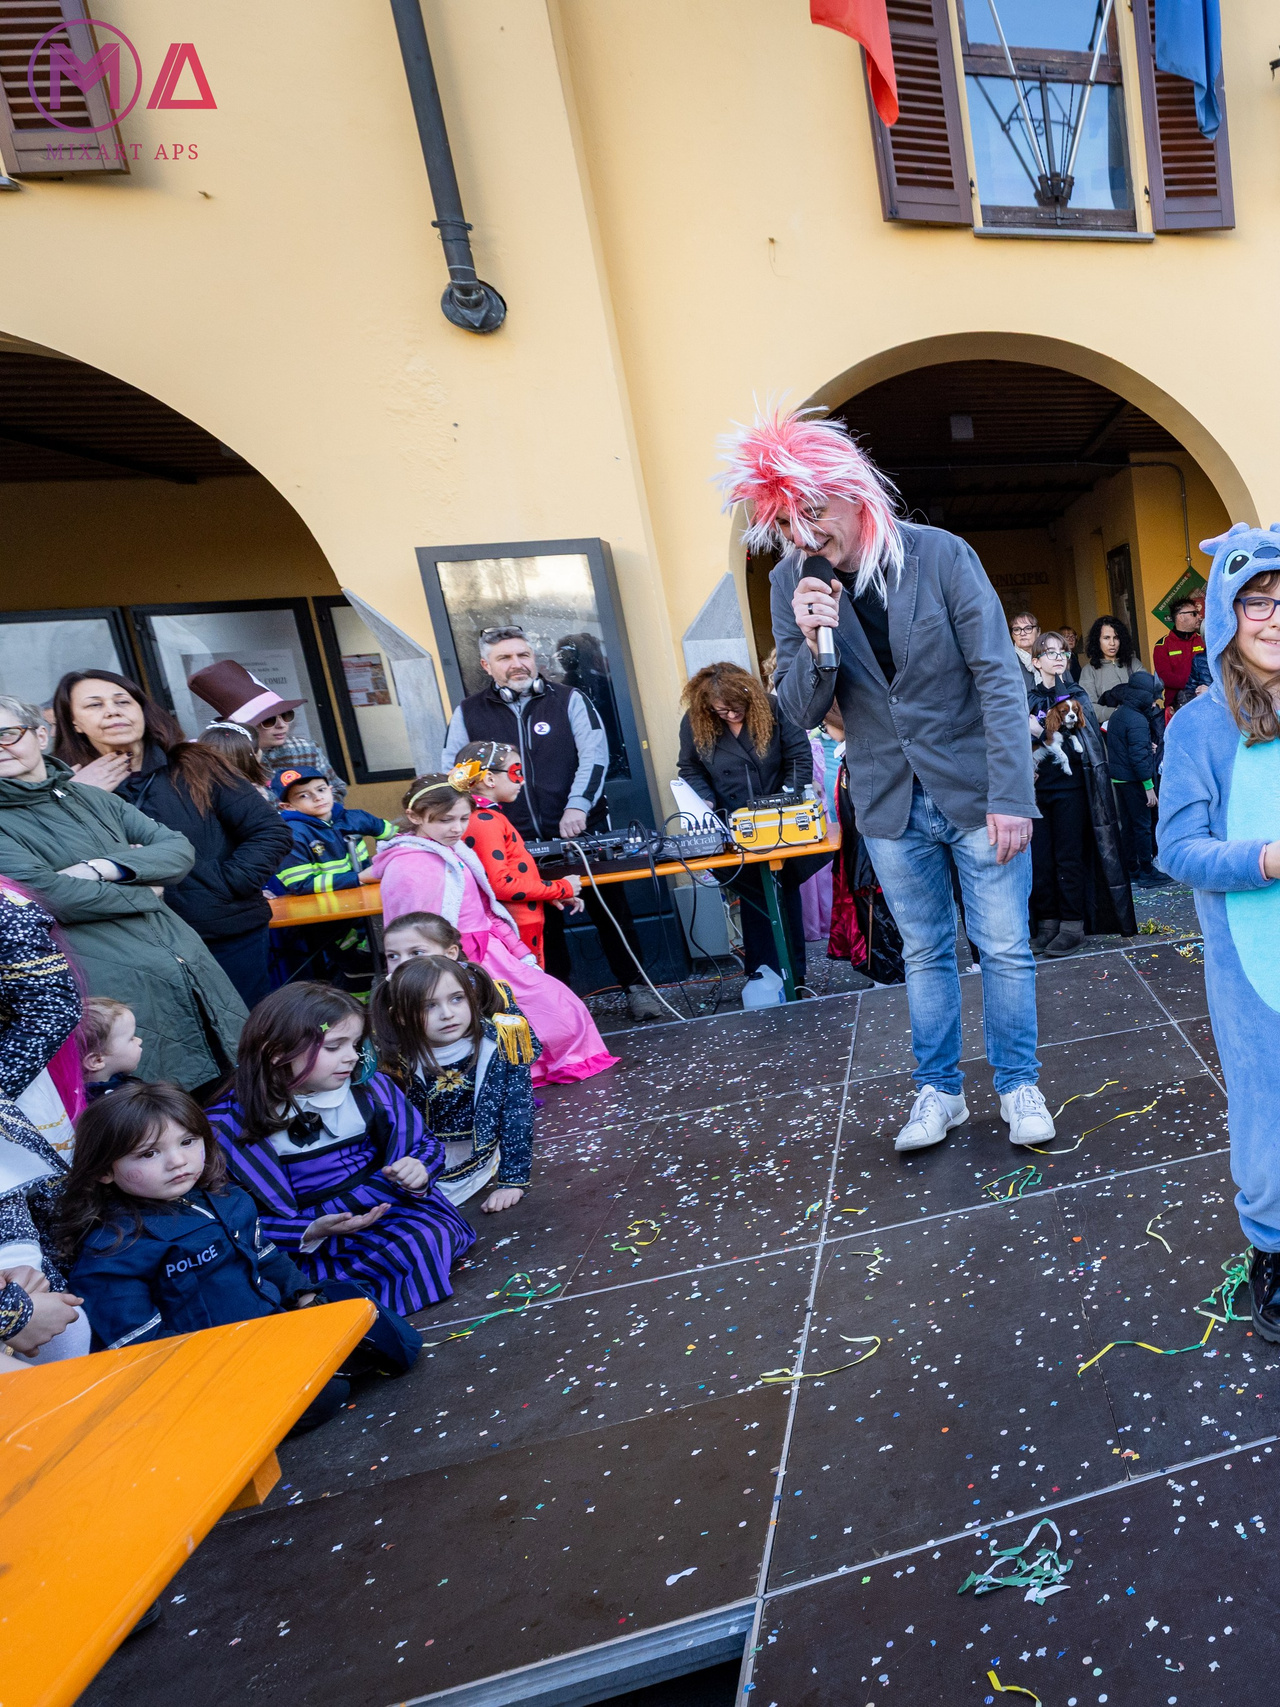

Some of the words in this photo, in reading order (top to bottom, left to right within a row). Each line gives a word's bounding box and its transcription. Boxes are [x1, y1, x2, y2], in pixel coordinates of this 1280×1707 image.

[988, 571, 1049, 588] UNICIPIO
[1158, 576, 1189, 611] DEFIBRILLATORE
[165, 1244, 218, 1278] POLICE
